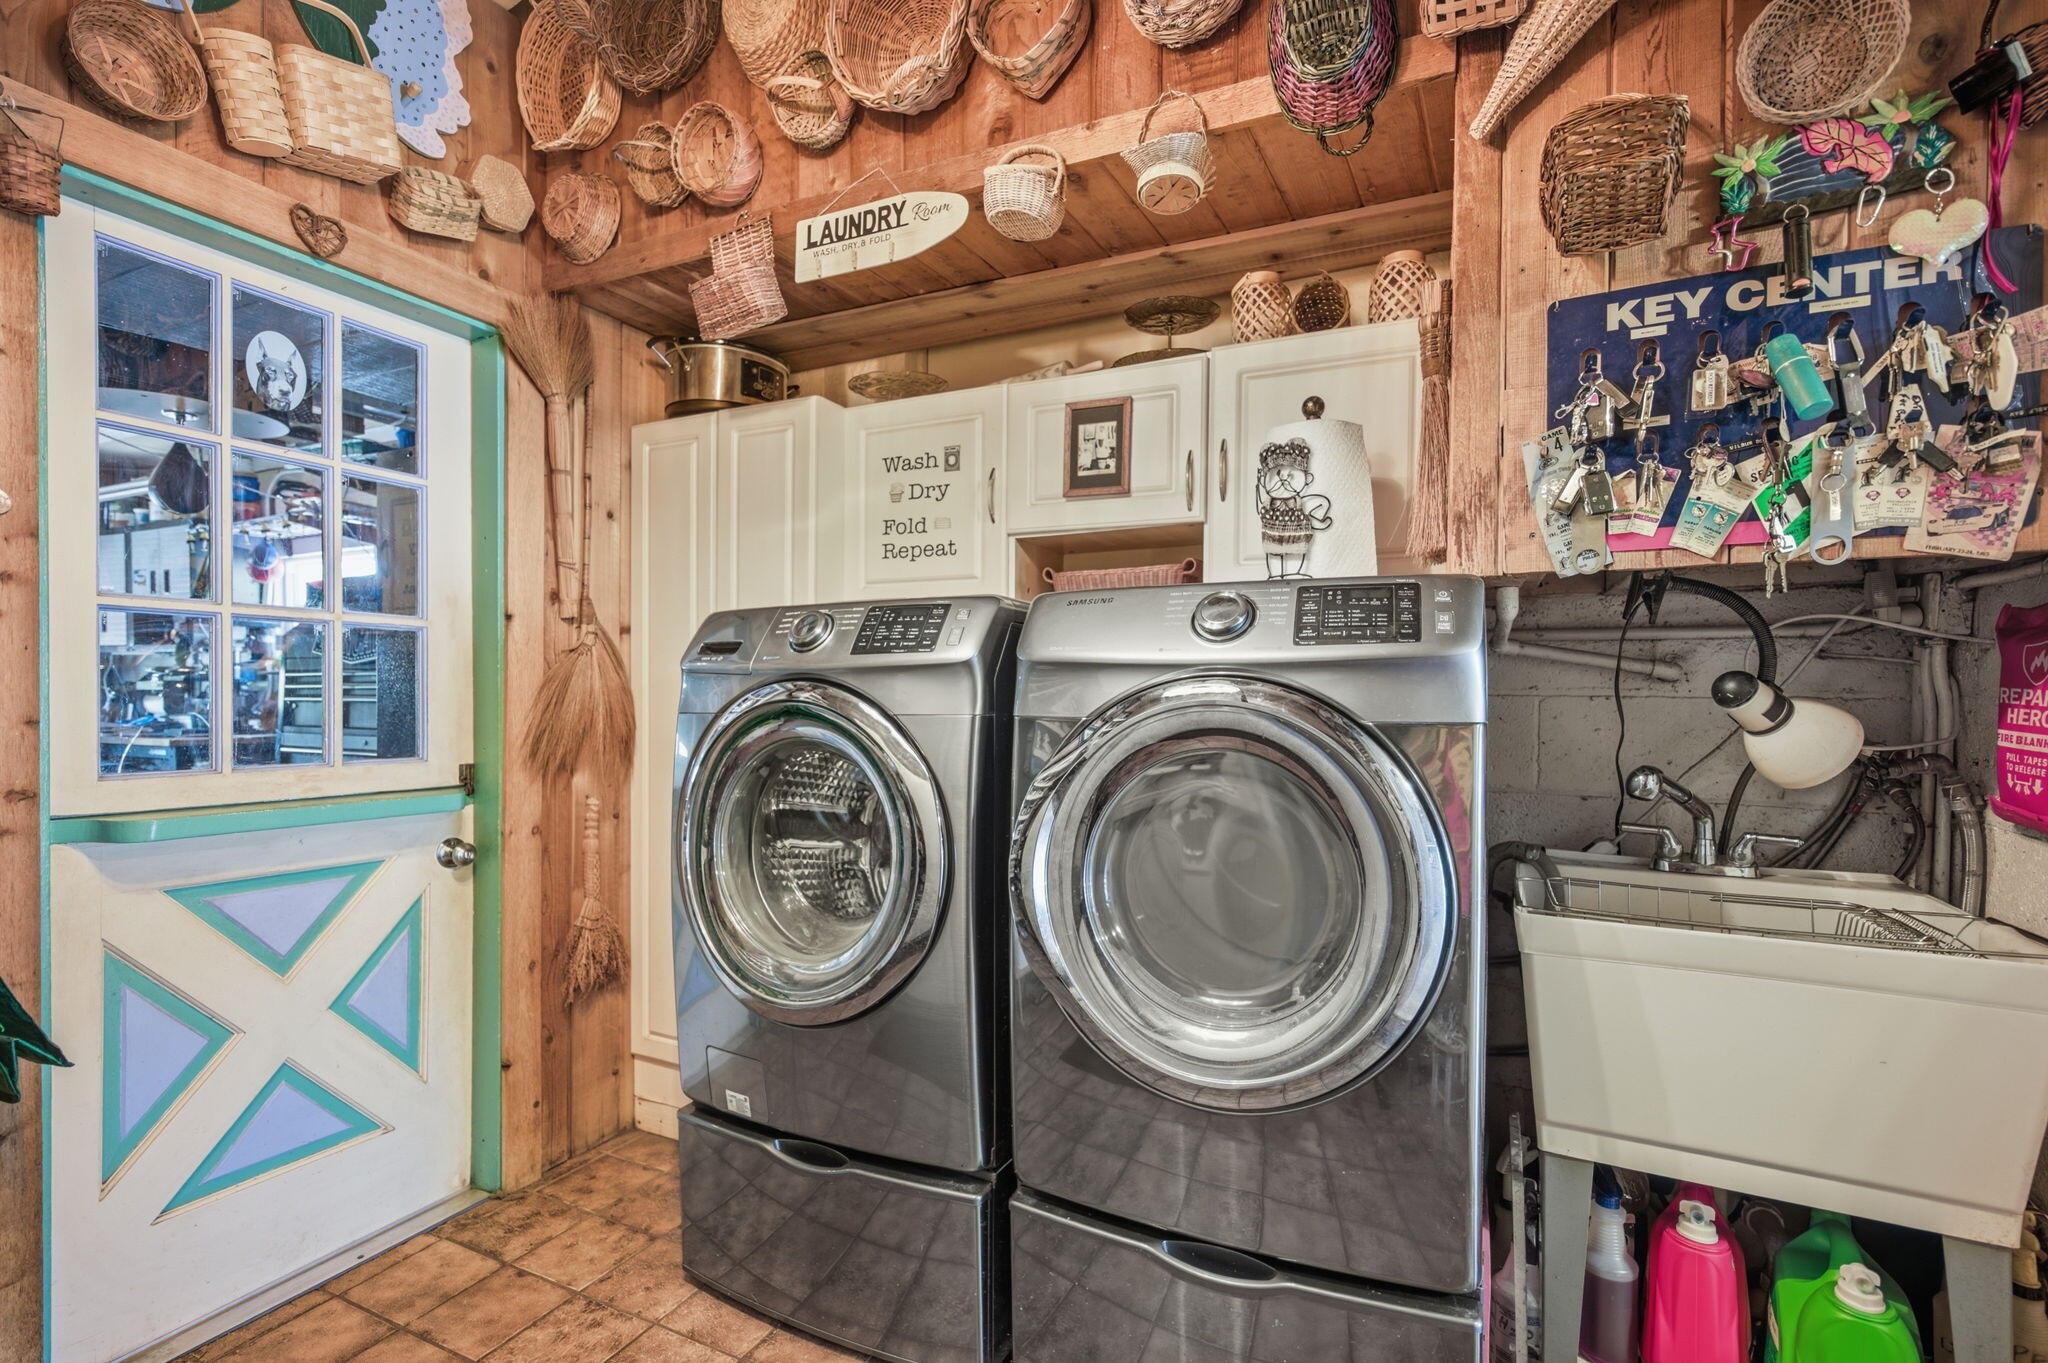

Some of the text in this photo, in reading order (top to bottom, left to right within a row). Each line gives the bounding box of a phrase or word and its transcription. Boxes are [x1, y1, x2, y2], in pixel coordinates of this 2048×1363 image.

[806, 200, 952, 248] LAUNDRY Room
[869, 233, 891, 245] FOLD
[1606, 257, 1963, 332] KEY CENTER
[1541, 428, 1564, 442] GAME
[1554, 437, 1563, 451] 4
[882, 452, 939, 473] Wash
[908, 483, 950, 501] Dry
[882, 517, 928, 535] Fold
[882, 539, 957, 562] Repeat
[1066, 597, 1114, 606] SAMSUNG
[2006, 752, 2048, 767] PULL TAPES
[2006, 762, 2047, 777] TO RELEASE
